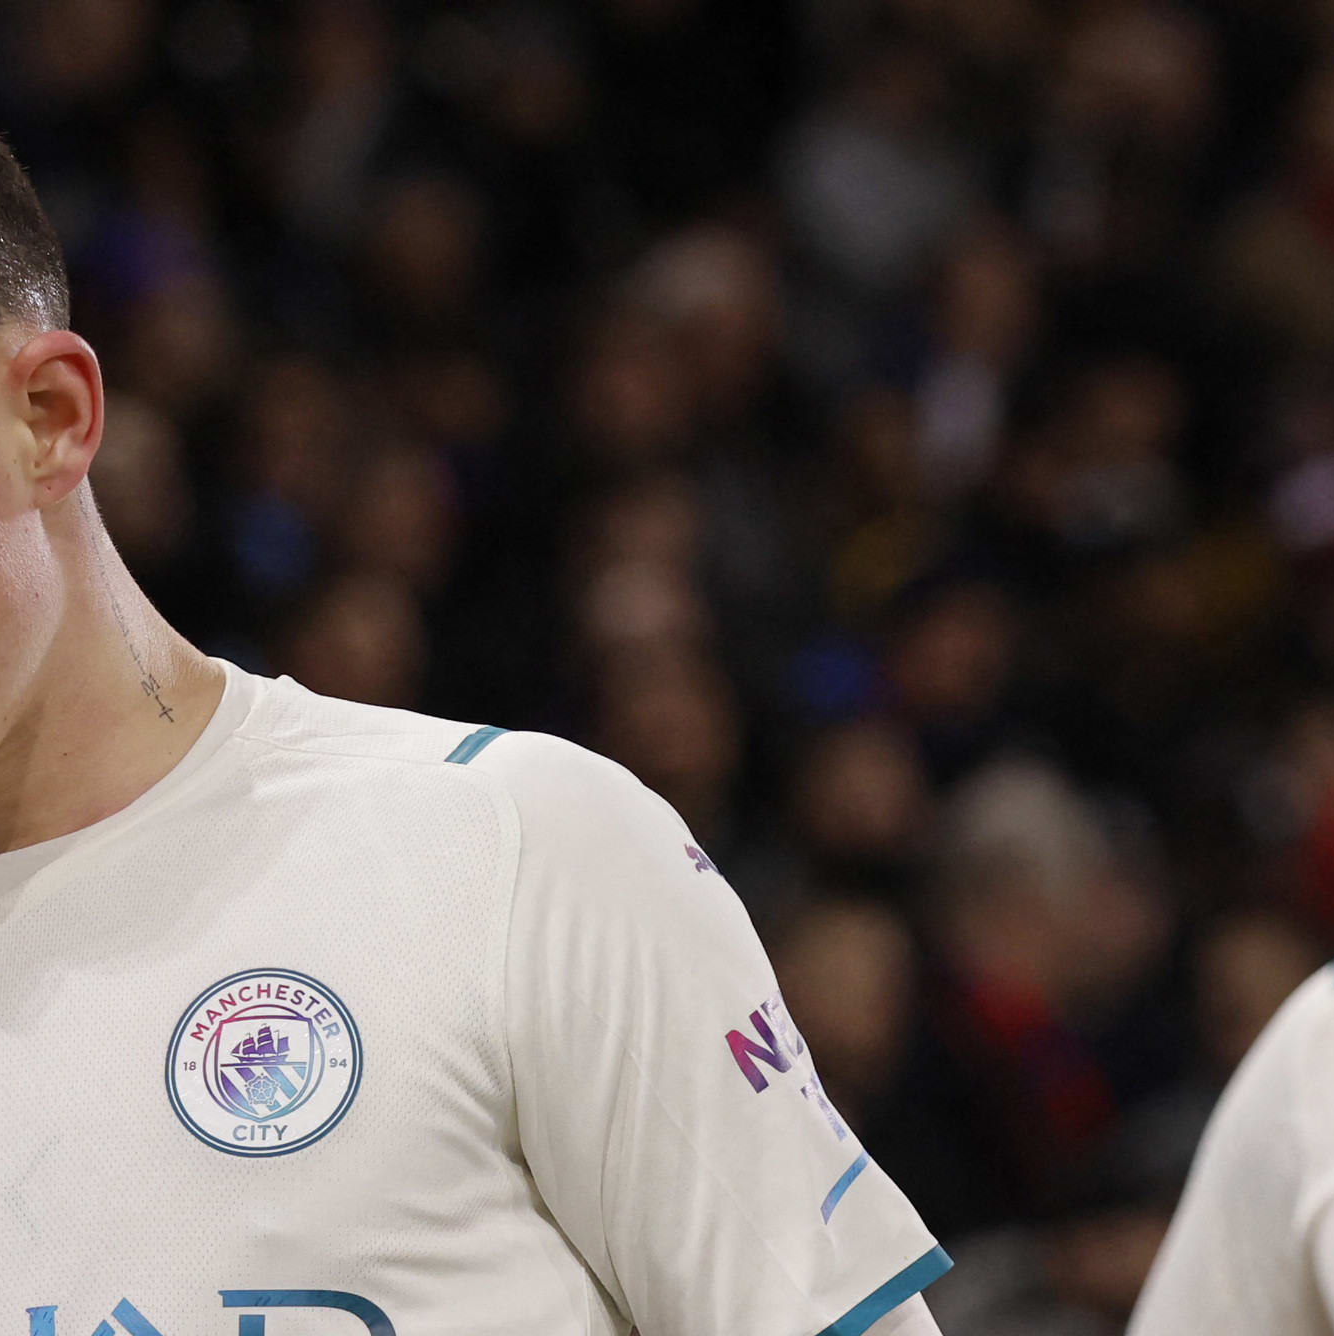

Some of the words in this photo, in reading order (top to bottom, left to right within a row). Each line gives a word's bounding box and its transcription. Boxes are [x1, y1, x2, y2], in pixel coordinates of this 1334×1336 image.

[190, 983, 340, 1041] MANCHESTER
[183, 1061, 197, 1071] 18
[329, 1058, 347, 1068] 94
[232, 1125, 288, 1141] CITY
